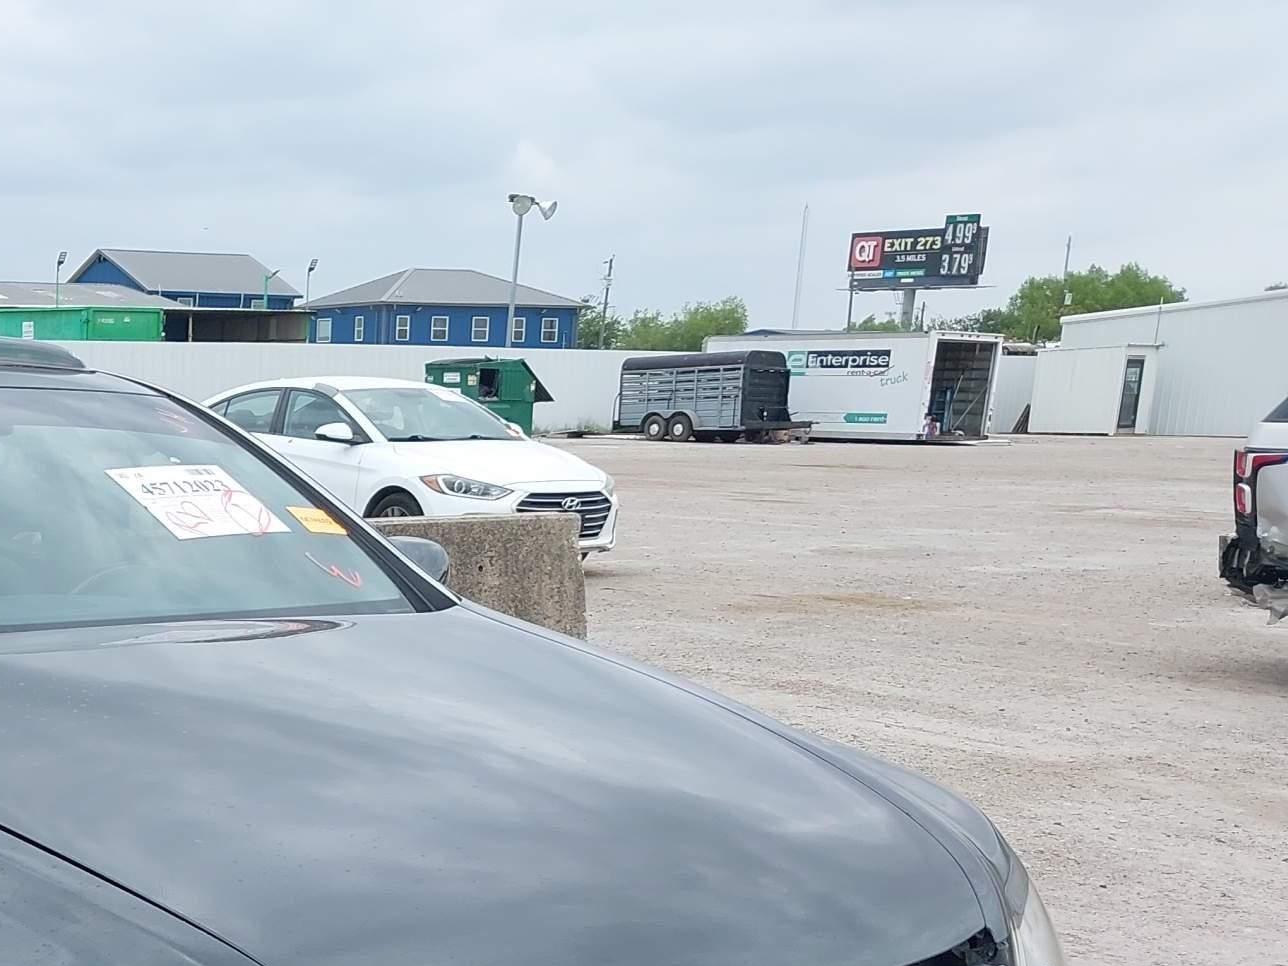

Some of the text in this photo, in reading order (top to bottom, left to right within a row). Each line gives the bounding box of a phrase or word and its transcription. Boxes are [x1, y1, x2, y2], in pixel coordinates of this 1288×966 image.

[855, 240, 878, 262] QT
[884, 236, 942, 252] EXIT 273
[906, 253, 926, 262] MILES
[807, 352, 889, 368] Enterprise
[880, 371, 909, 387] truck
[141, 480, 231, 495] 45712023
